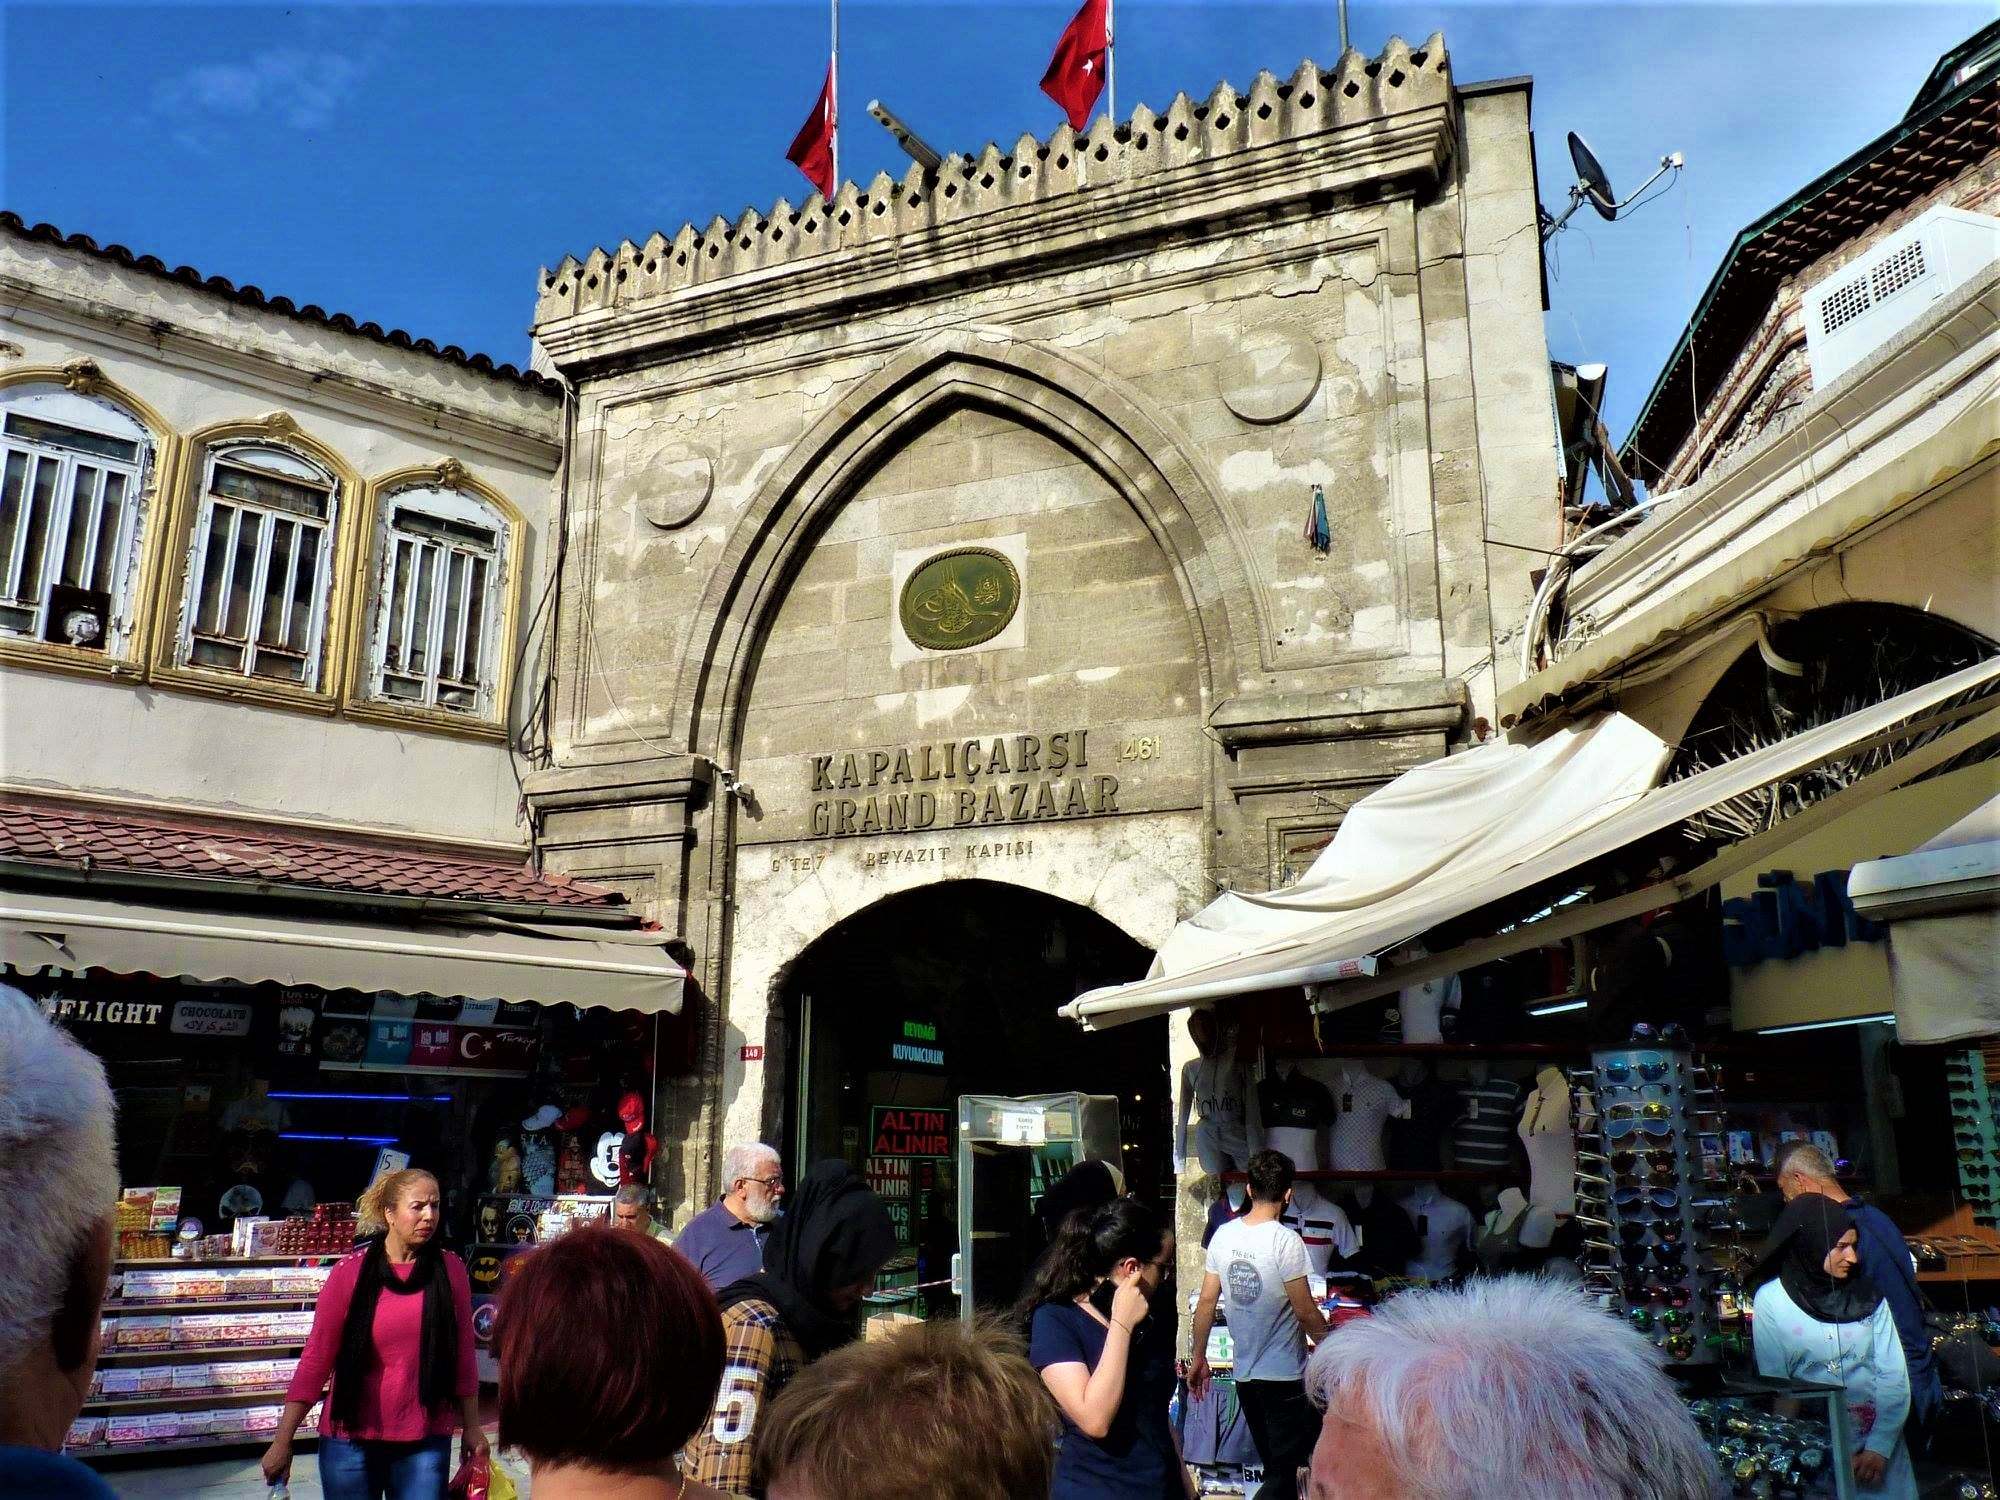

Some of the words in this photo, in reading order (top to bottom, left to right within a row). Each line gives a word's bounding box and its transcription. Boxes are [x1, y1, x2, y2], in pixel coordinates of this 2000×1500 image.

[810, 729, 1090, 792] KAPALIÇARŞI
[1114, 735, 1161, 763] 1461
[810, 790, 936, 837] GRAND
[953, 773, 1120, 825] BAZAAR
[865, 847, 951, 868] BEYAZIT
[965, 840, 1034, 860] KAPISI
[891, 1042, 945, 1066] KUYUMCULUK
[880, 1111, 946, 1132] ALTIN
[874, 1134, 949, 1155] ALINIR
[864, 1158, 911, 1176] ALTIN
[712, 1367, 758, 1444] 5
